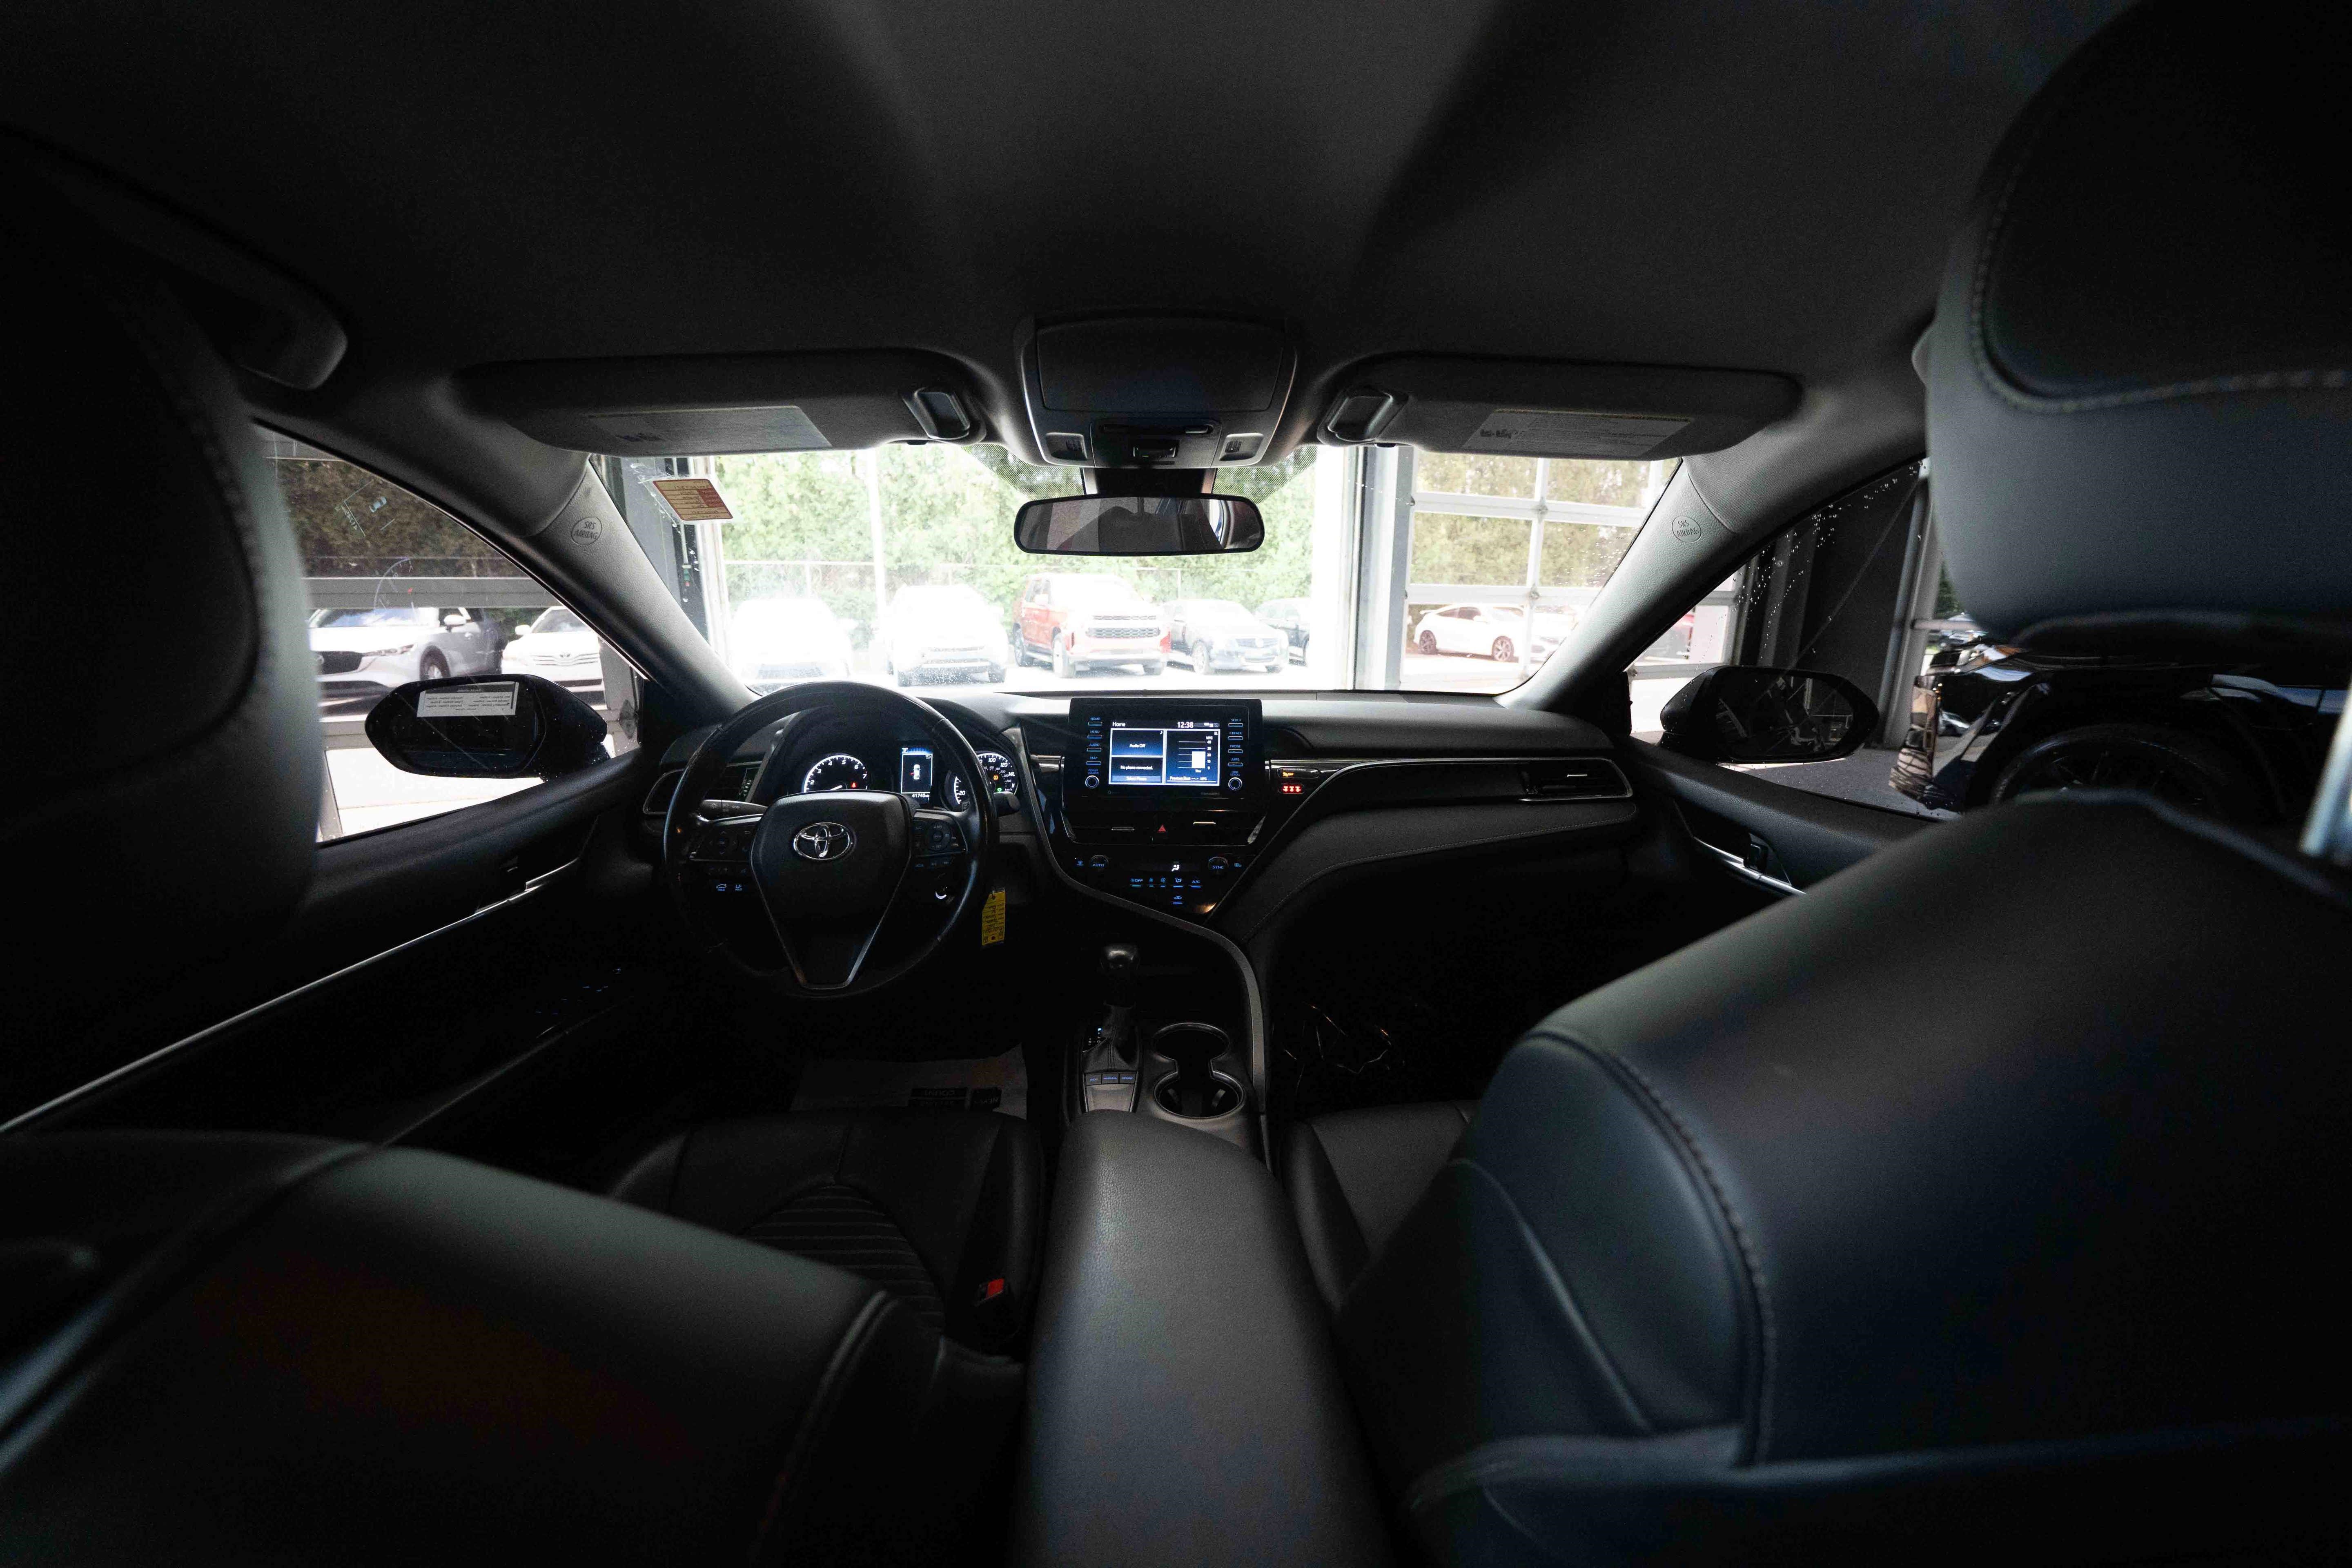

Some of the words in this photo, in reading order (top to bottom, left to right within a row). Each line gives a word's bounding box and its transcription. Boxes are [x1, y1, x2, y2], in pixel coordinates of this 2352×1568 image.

[584, 521, 596, 530] SRS
[1677, 519, 1690, 528] SRS
[573, 530, 598, 539] AIRBAG
[1677, 527, 1699, 537] AIRBAG
